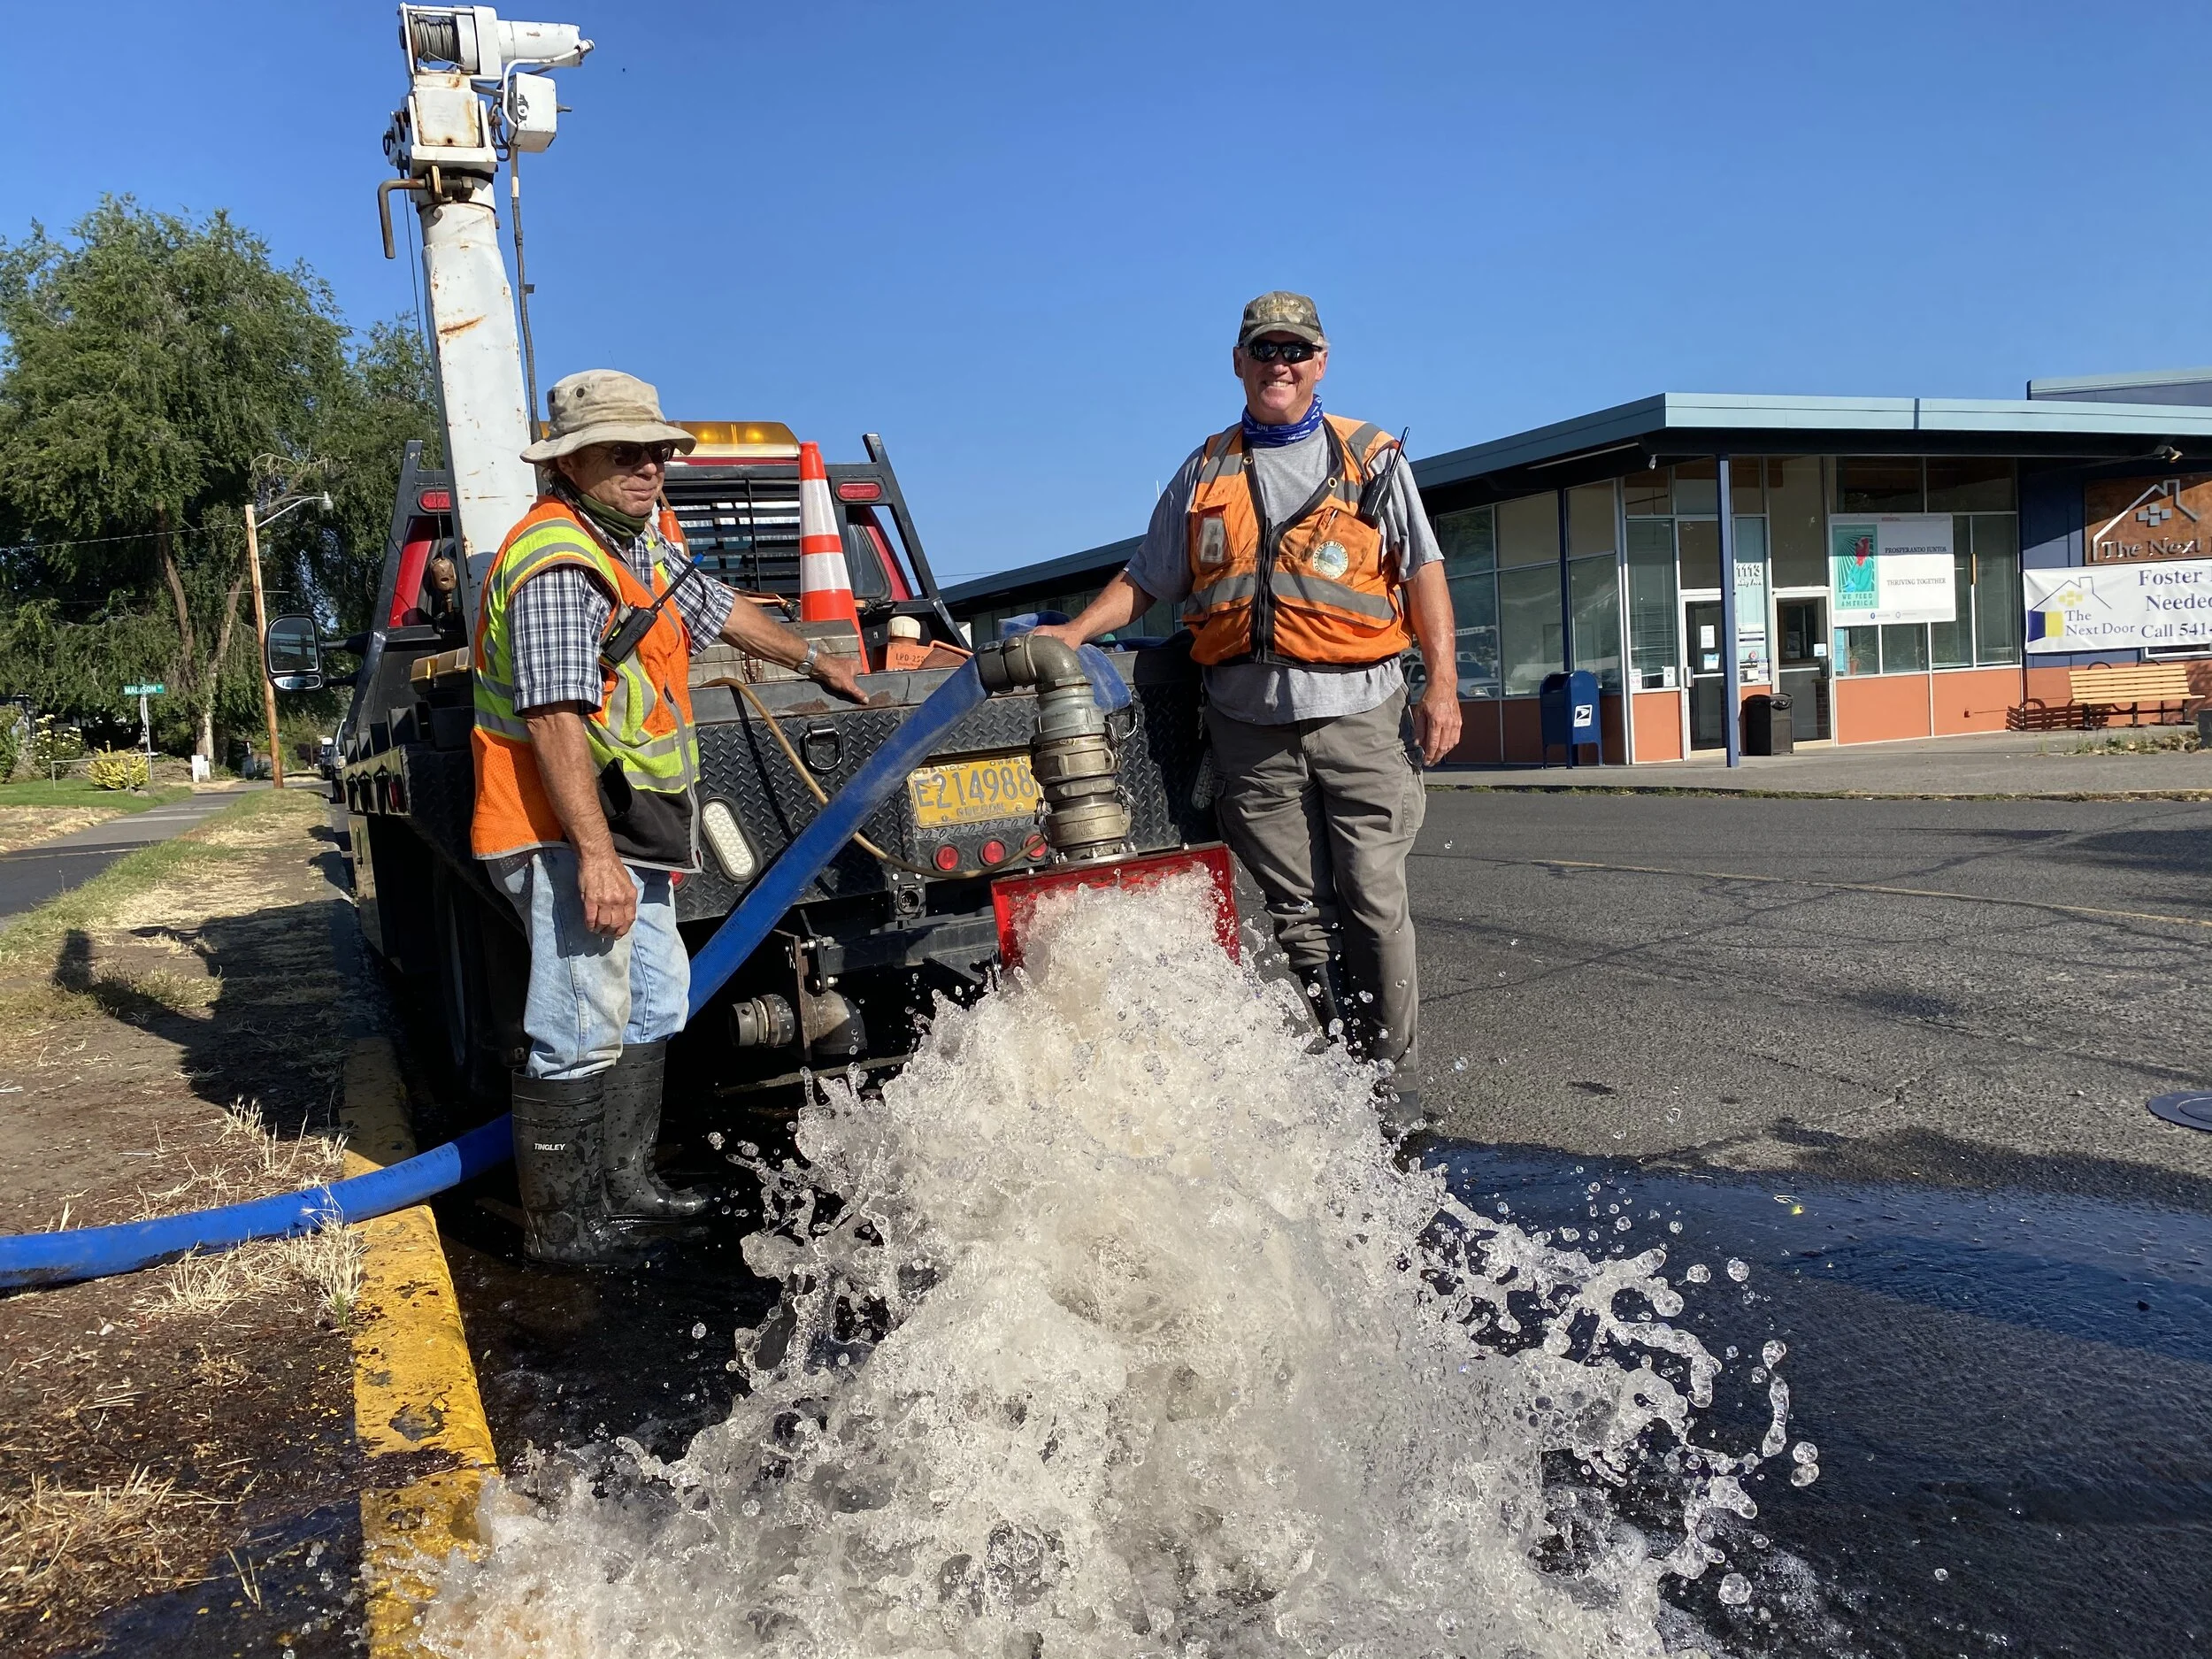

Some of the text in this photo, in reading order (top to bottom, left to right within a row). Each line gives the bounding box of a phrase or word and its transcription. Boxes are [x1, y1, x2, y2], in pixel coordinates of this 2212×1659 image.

[2101, 536, 2201, 559] The Next
[1736, 564, 1760, 577] 1113
[2139, 569, 2203, 586] Foster
[2064, 610, 2092, 621] The
[2066, 622, 2135, 636] Next Door
[2141, 624, 2173, 638] Call
[913, 764, 970, 776] PUBLICLY
[914, 764, 1034, 809] E214988
[534, 1142, 566, 1151] TINGLEY
